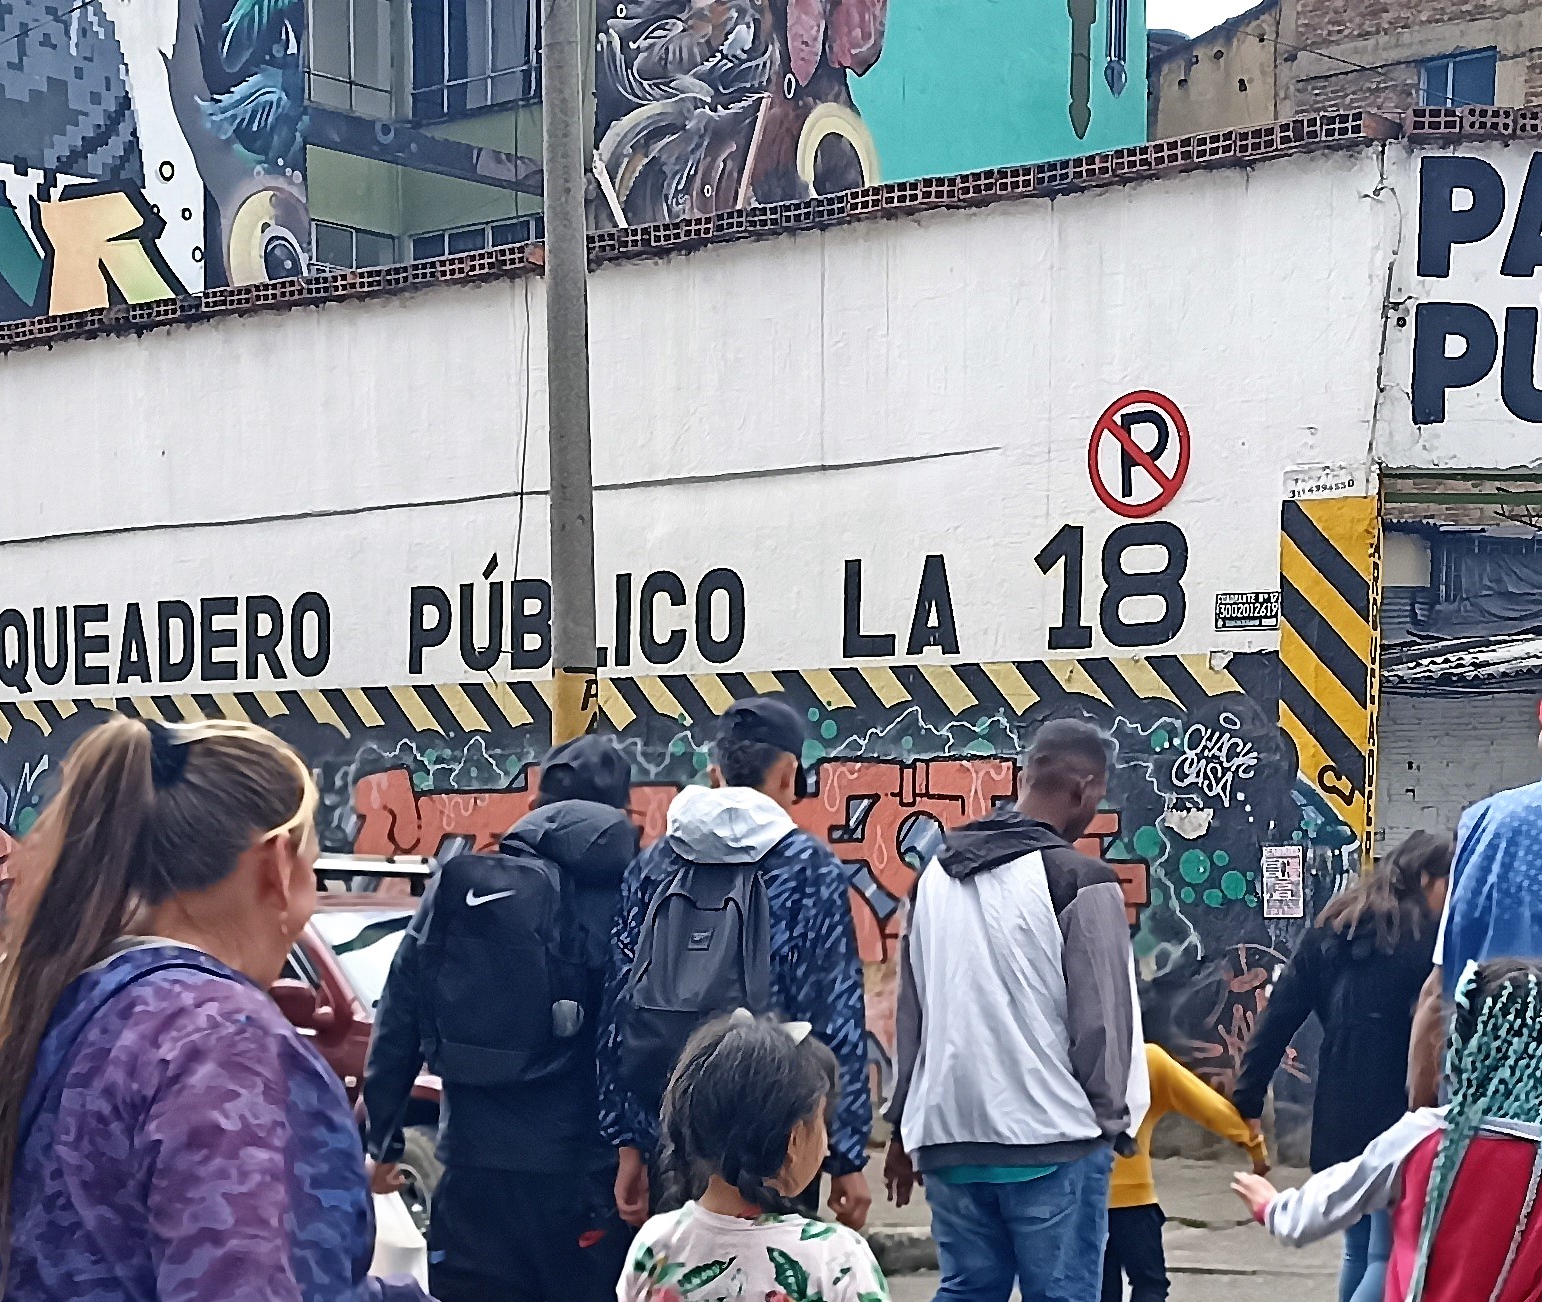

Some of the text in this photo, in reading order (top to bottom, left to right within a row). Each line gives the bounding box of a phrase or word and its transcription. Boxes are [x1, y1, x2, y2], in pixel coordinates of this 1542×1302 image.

[409, 552, 745, 674] PÚBICO
[843, 554, 959, 658] LA
[1034, 520, 1189, 650] 18
[1365, 489, 1382, 857] PARQUEADER
